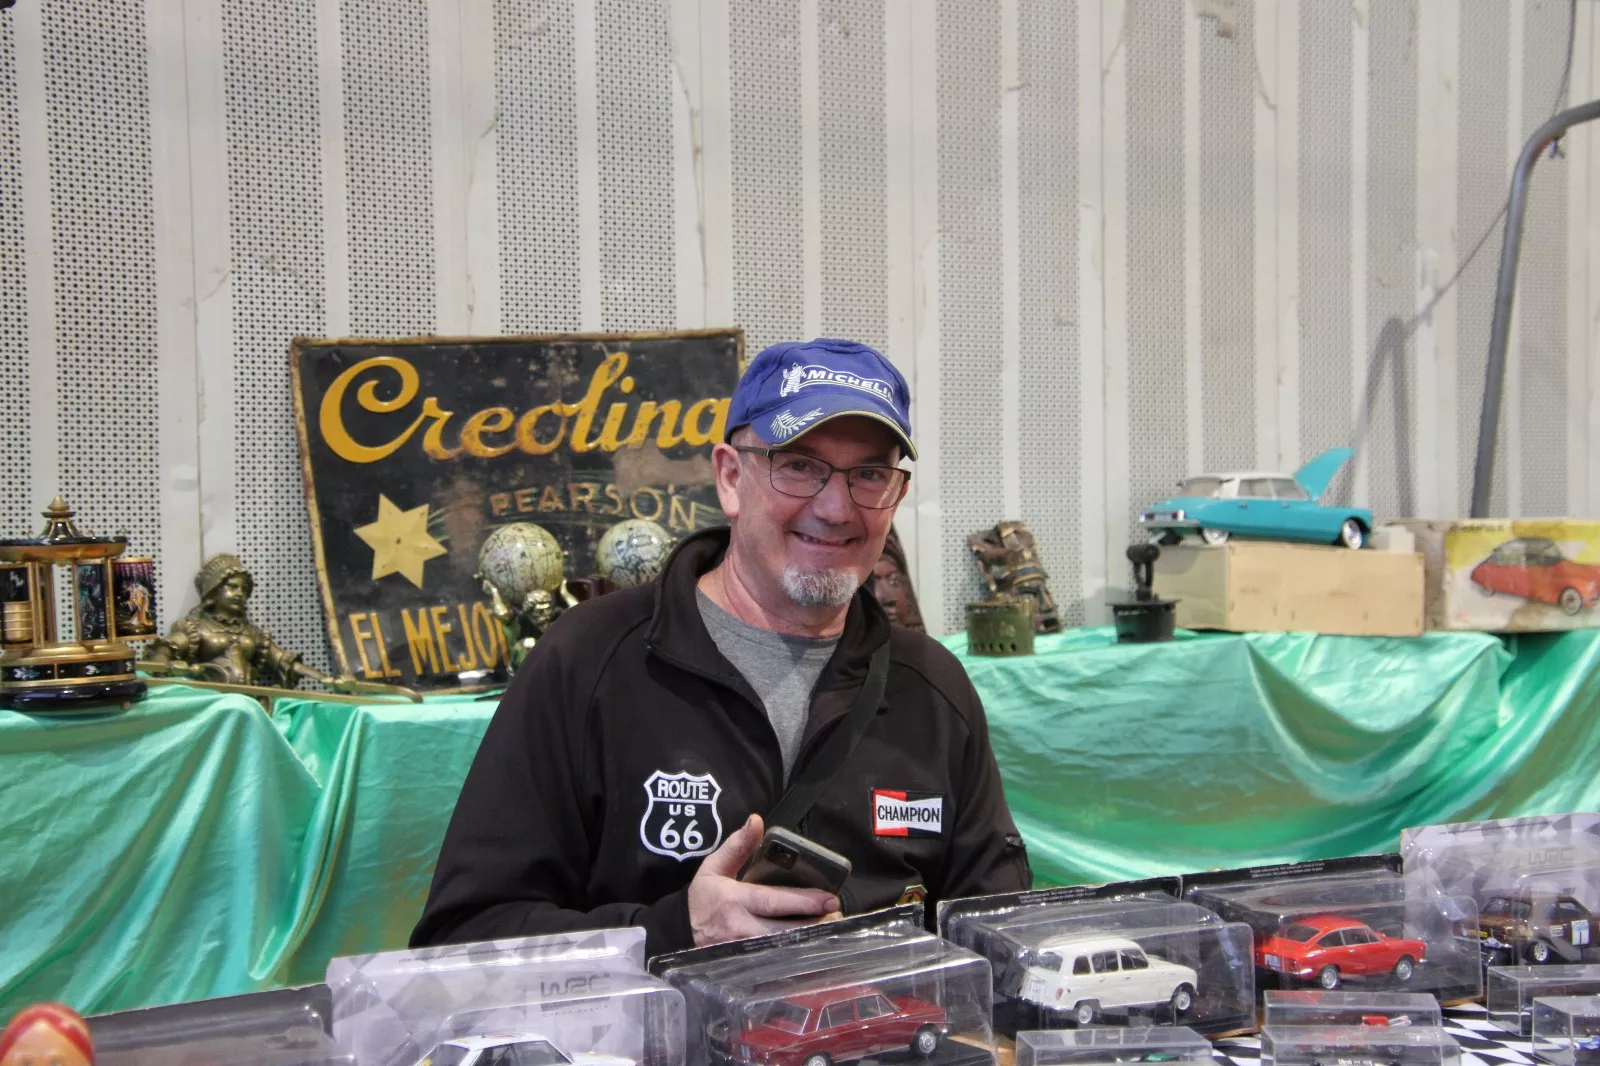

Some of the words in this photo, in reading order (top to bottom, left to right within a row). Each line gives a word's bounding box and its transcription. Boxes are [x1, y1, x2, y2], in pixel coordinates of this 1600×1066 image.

[319, 352, 732, 463] Creolina
[490, 482, 698, 532] PEARSON
[348, 611, 402, 679] EL
[401, 601, 511, 676] MEJO
[657, 779, 709, 799] ROUTE
[877, 804, 940, 823] CHAMPION
[660, 818, 703, 850] 66
[540, 971, 611, 998] WRC
